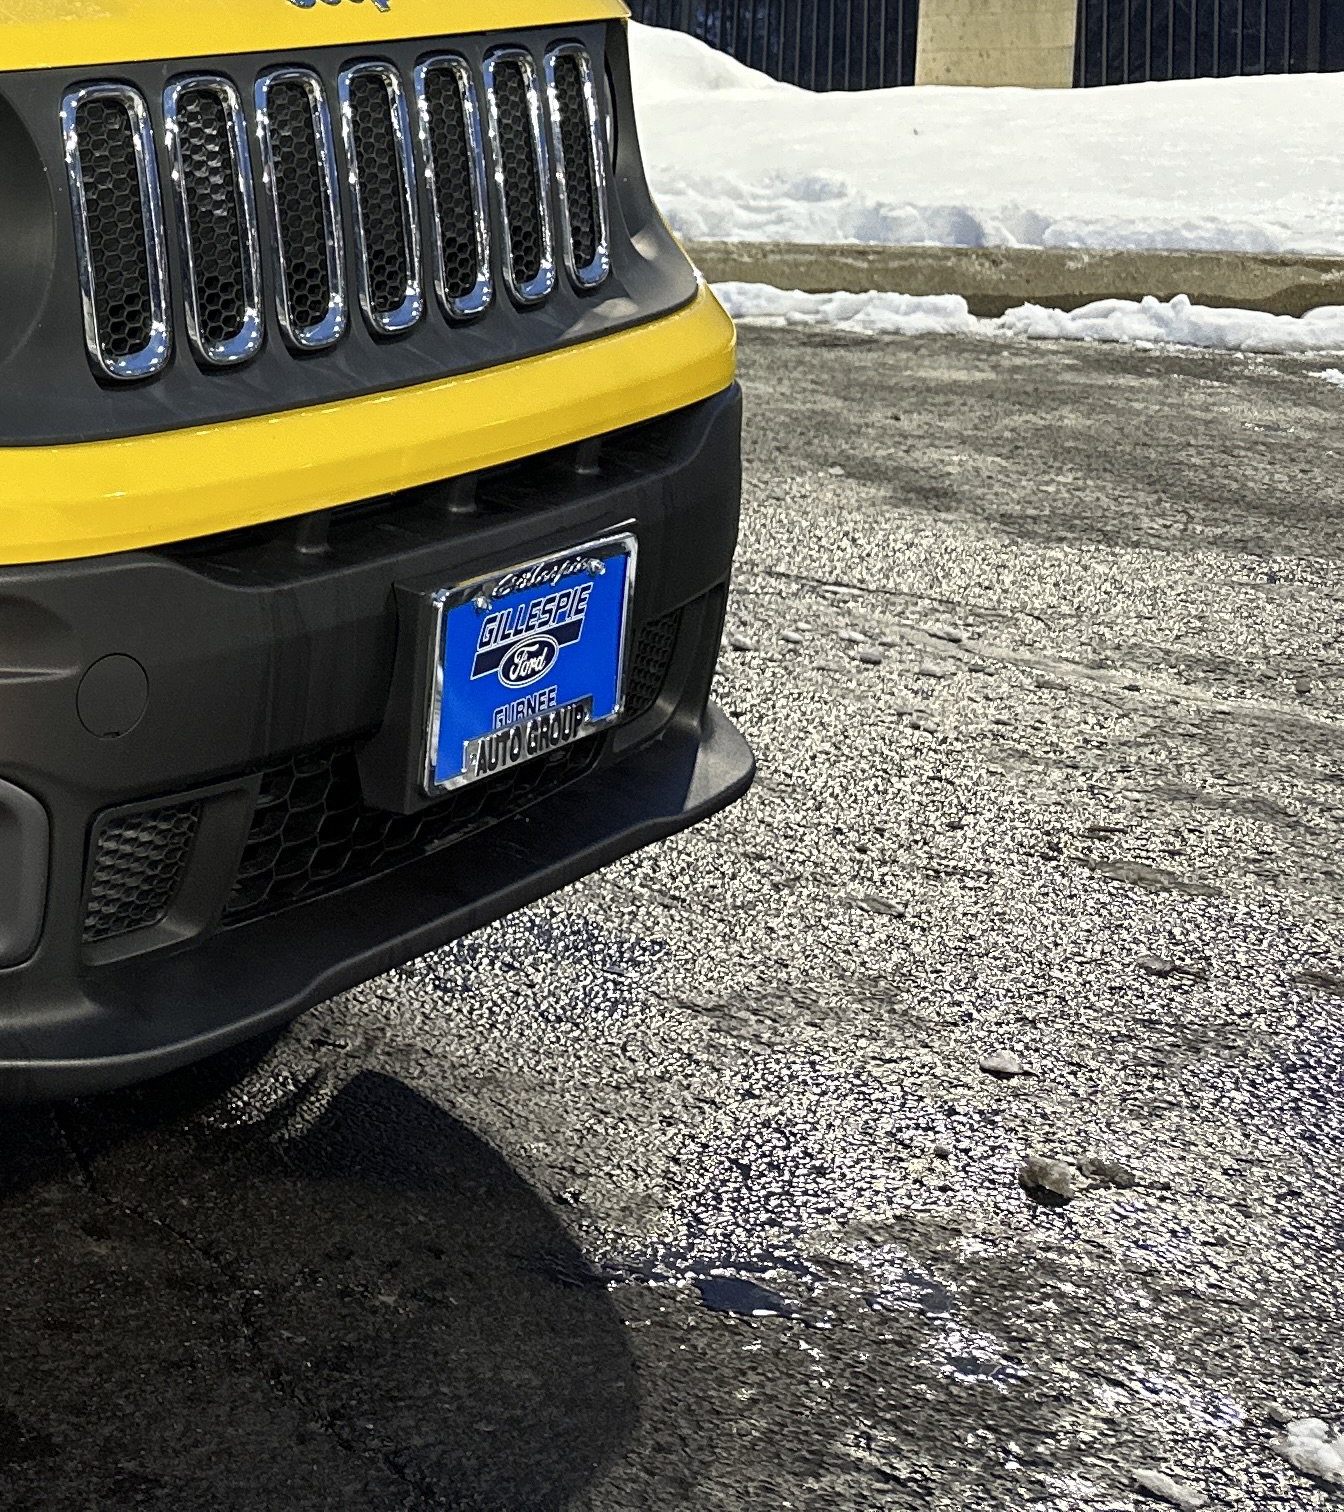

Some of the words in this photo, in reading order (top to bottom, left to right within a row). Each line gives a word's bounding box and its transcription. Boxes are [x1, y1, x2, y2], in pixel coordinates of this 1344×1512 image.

[476, 582, 594, 652] GILLESPIE
[509, 642, 547, 681] Ford
[492, 685, 558, 730] GURNEE
[475, 726, 522, 777] AUTO
[526, 703, 584, 756] GROUP
